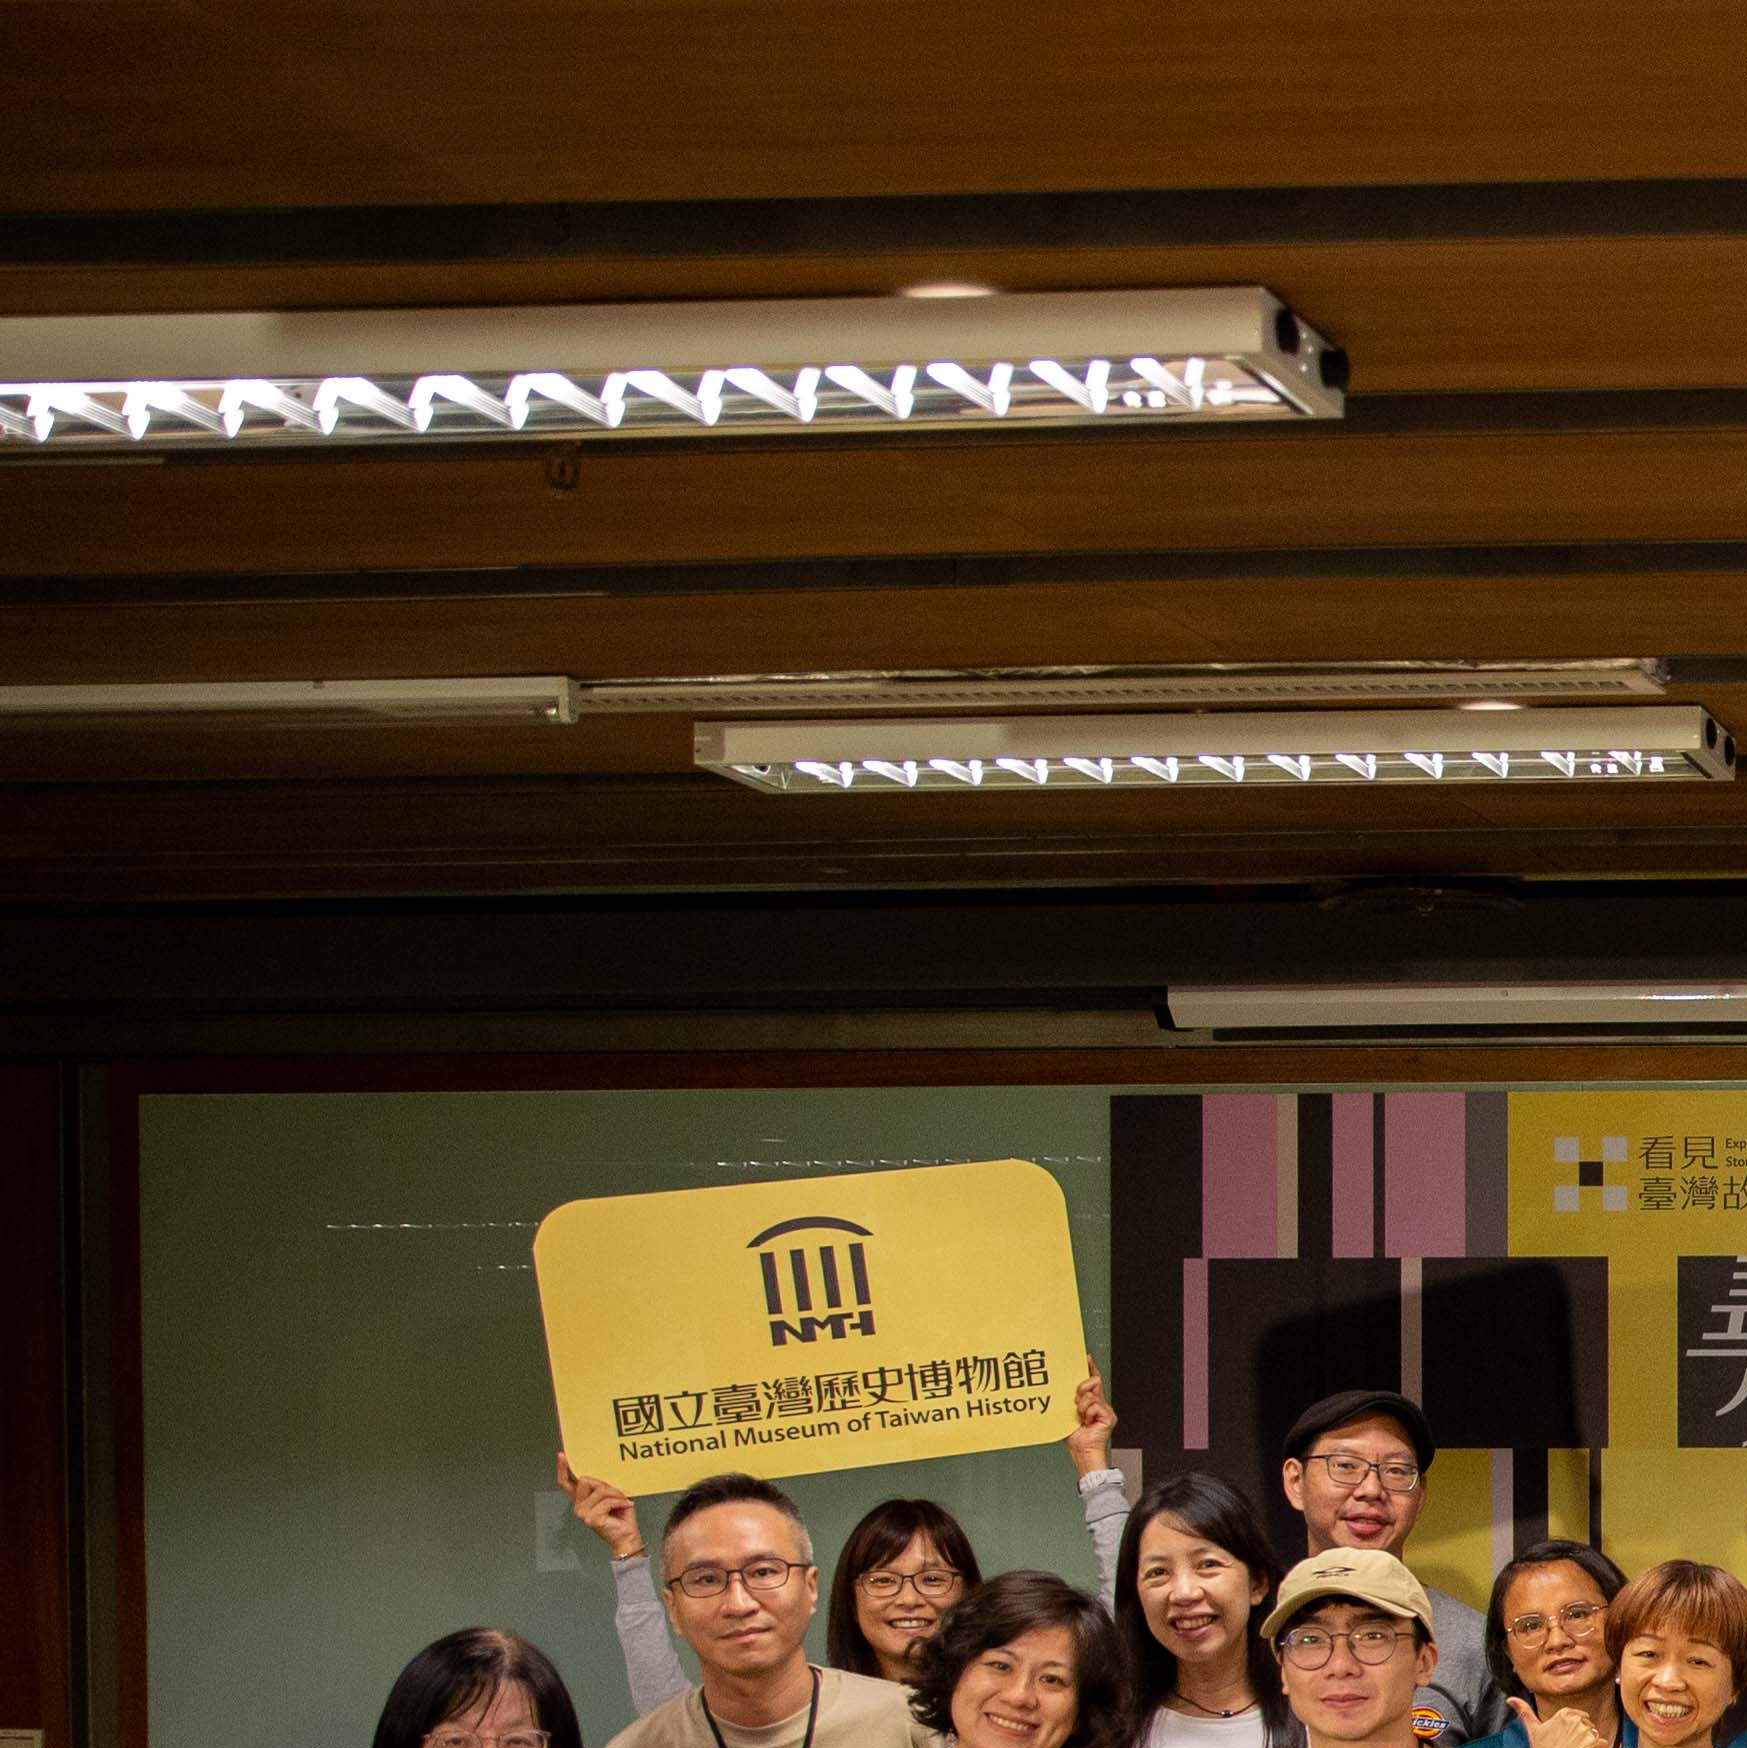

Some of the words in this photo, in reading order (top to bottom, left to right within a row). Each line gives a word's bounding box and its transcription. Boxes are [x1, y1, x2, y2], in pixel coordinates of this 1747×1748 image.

[1639, 1136, 1719, 1170] 看見
[613, 1348, 1049, 1437] 國立臺灣歷史博物館
[618, 1428, 727, 1462] National
[733, 1419, 841, 1447] Museum
[847, 1411, 872, 1433] of
[874, 1402, 961, 1429] Taiwan
[966, 1393, 1051, 1419] History
[1412, 1716, 1447, 1729] ickies
